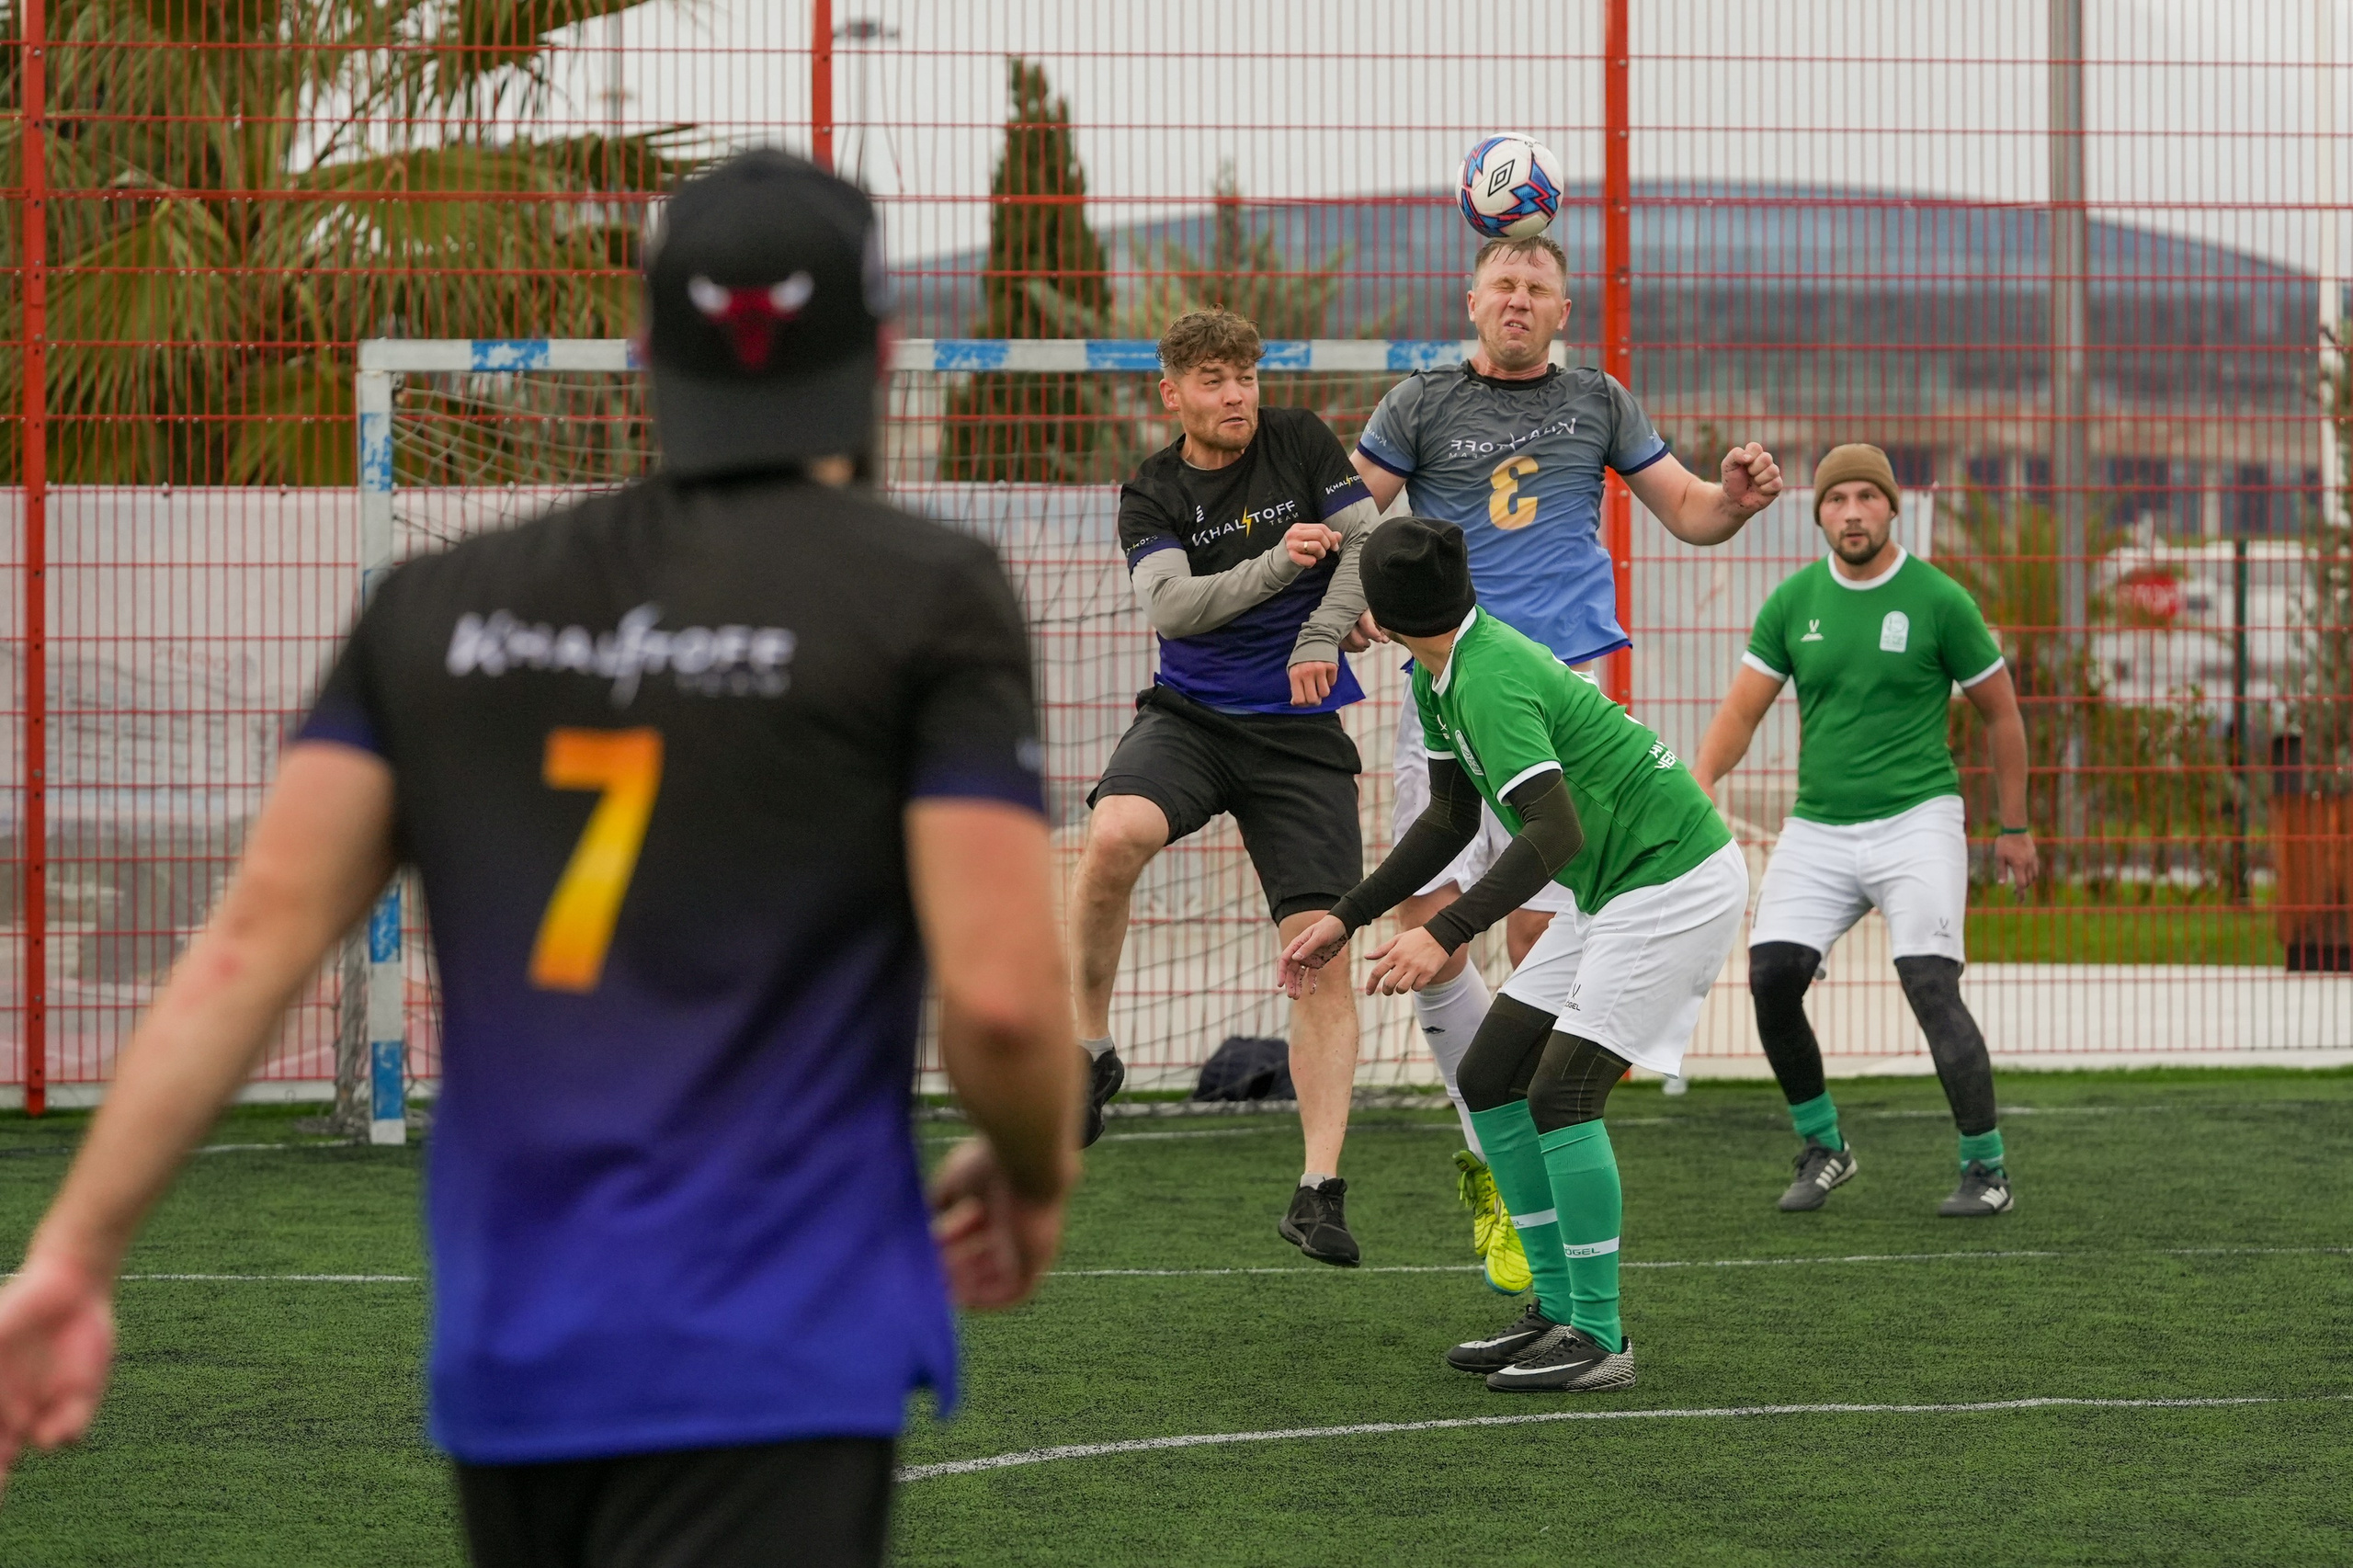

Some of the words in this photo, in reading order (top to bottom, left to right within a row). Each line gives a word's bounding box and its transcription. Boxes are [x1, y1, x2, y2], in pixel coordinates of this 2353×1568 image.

[529, 726, 665, 994] 7
[1564, 1000, 1581, 1012] ÖGEL
[1564, 1246, 1601, 1256] ÖGEL
